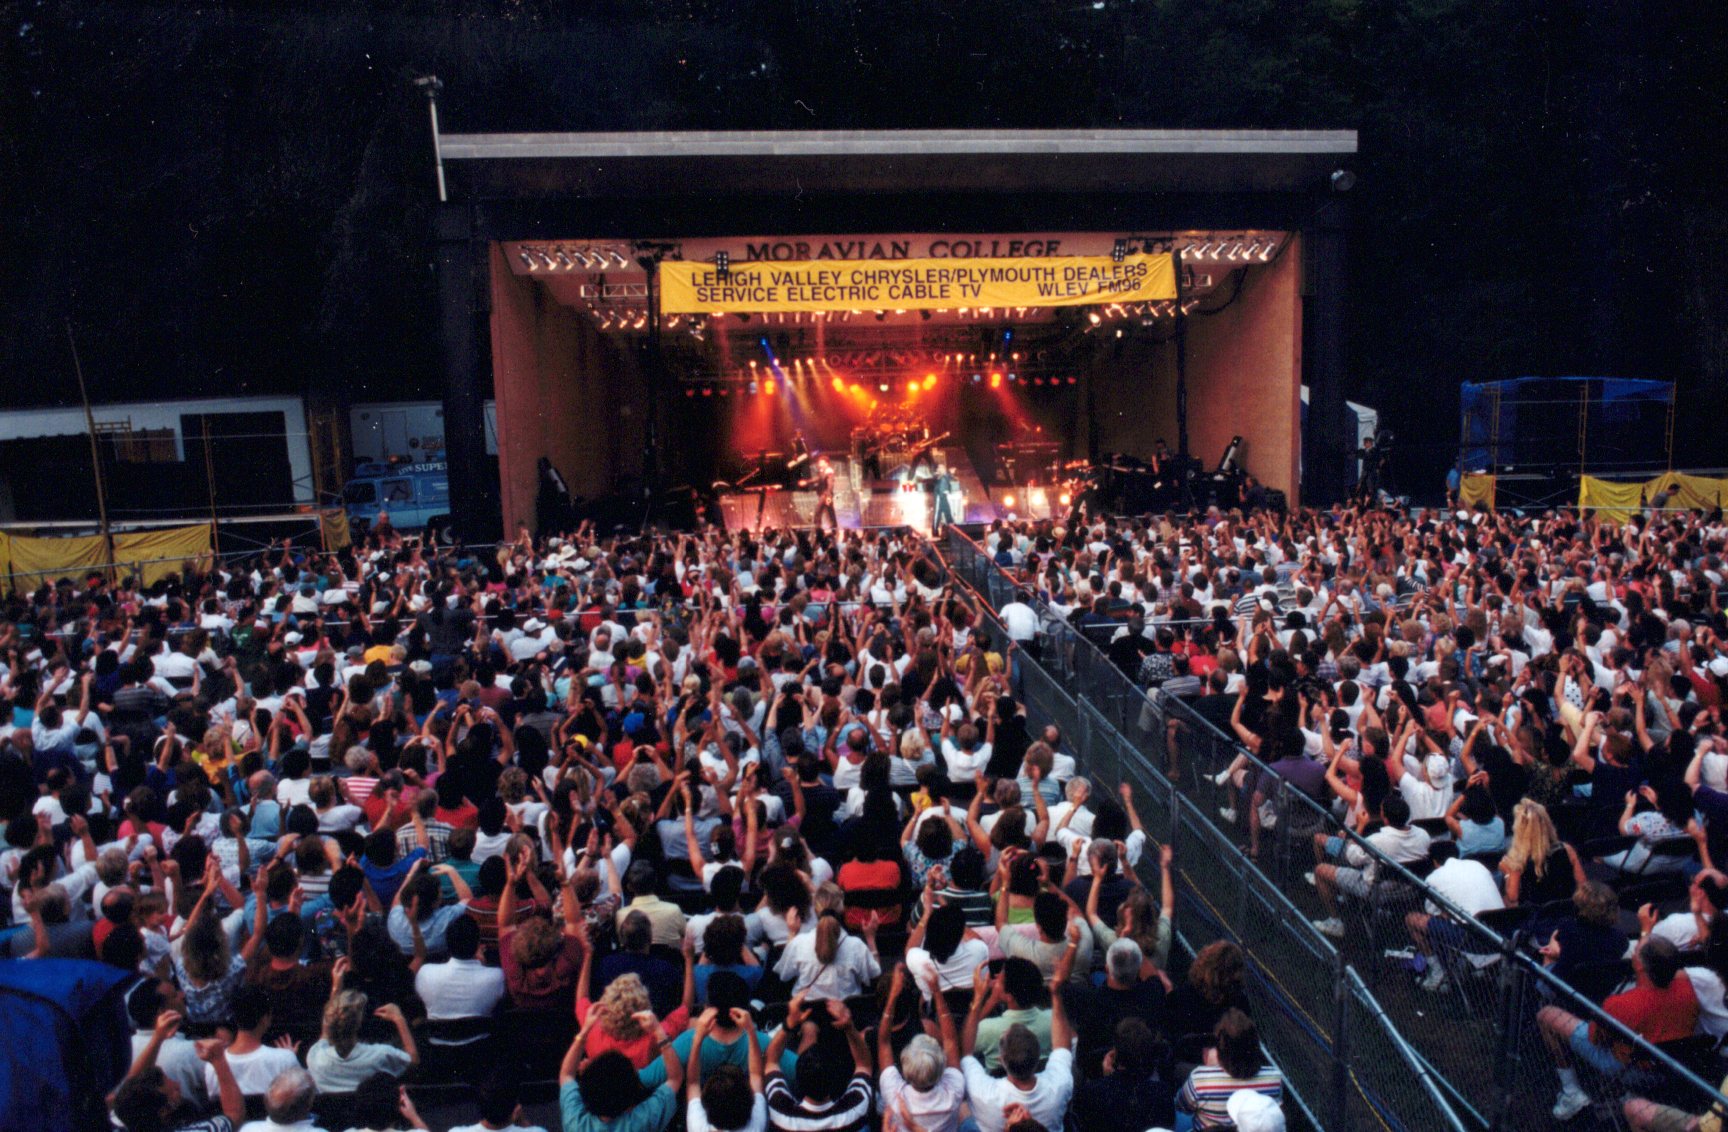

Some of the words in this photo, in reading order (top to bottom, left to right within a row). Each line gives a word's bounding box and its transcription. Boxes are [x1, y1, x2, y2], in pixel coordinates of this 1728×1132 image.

[747, 241, 911, 261] MORAVIAN
[929, 240, 1062, 258] COLLEGE
[692, 271, 762, 287] LEHIGH
[771, 270, 841, 286] VALLEY
[851, 266, 1055, 285] CHRYSLER/PLYMOUTH
[1064, 263, 1148, 281] DEALERS
[697, 287, 778, 303] SERVICE
[787, 286, 880, 302] ELECTRIC
[889, 284, 950, 300] CABLE
[961, 284, 981, 298] TV
[1037, 282, 1089, 297] WLEV
[1097, 278, 1141, 294] FM96
